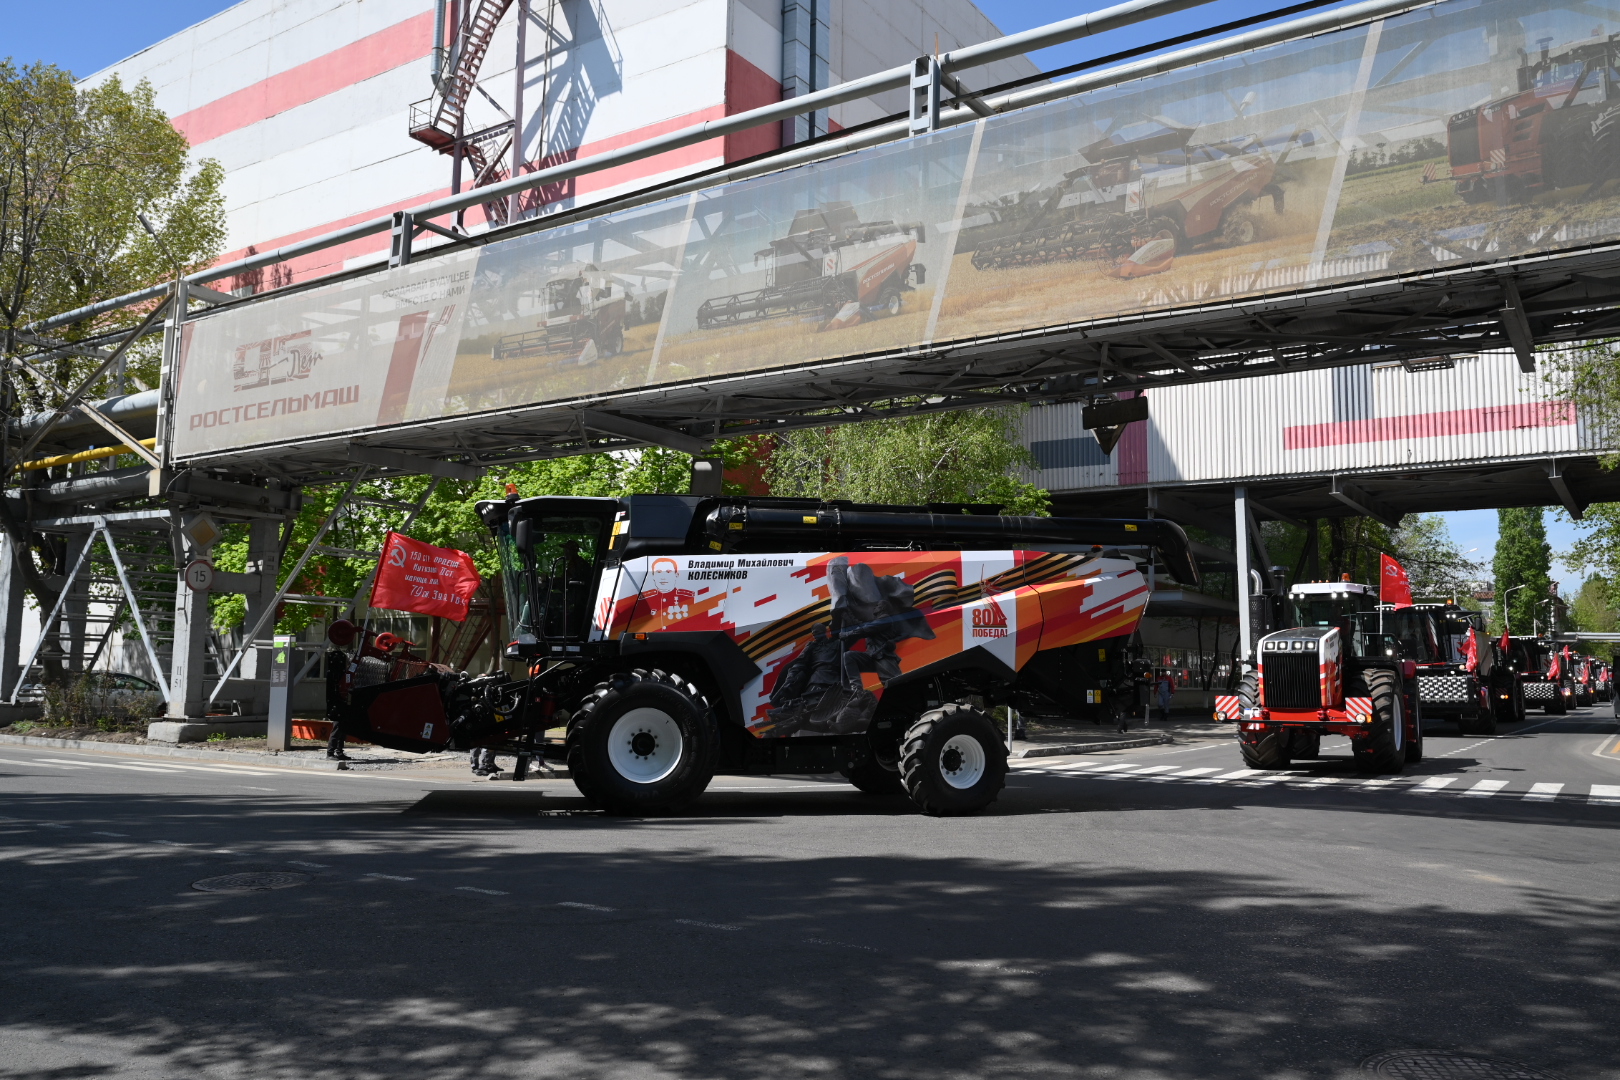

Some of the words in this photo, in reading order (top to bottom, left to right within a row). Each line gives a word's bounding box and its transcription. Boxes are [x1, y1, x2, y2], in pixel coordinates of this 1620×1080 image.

[382, 278, 428, 299] СОЗДАВАЙ
[429, 270, 470, 287] БУДУЩЕЕ
[395, 294, 430, 309] ВМЕСТЕ
[431, 292, 438, 301] С
[439, 285, 465, 300] НАМИ
[189, 384, 360, 431] РОСТСЕЛЬМАШ
[410, 551, 422, 561] 150
[688, 560, 735, 569] Владимир
[737, 558, 794, 567] Михайлович
[194, 570, 206, 582] 15
[688, 570, 748, 580] КОЛЕСНИКОВ
[410, 585, 424, 597] 79
[972, 608, 992, 626] 80
[972, 629, 1008, 638] ПОБЕДА!
